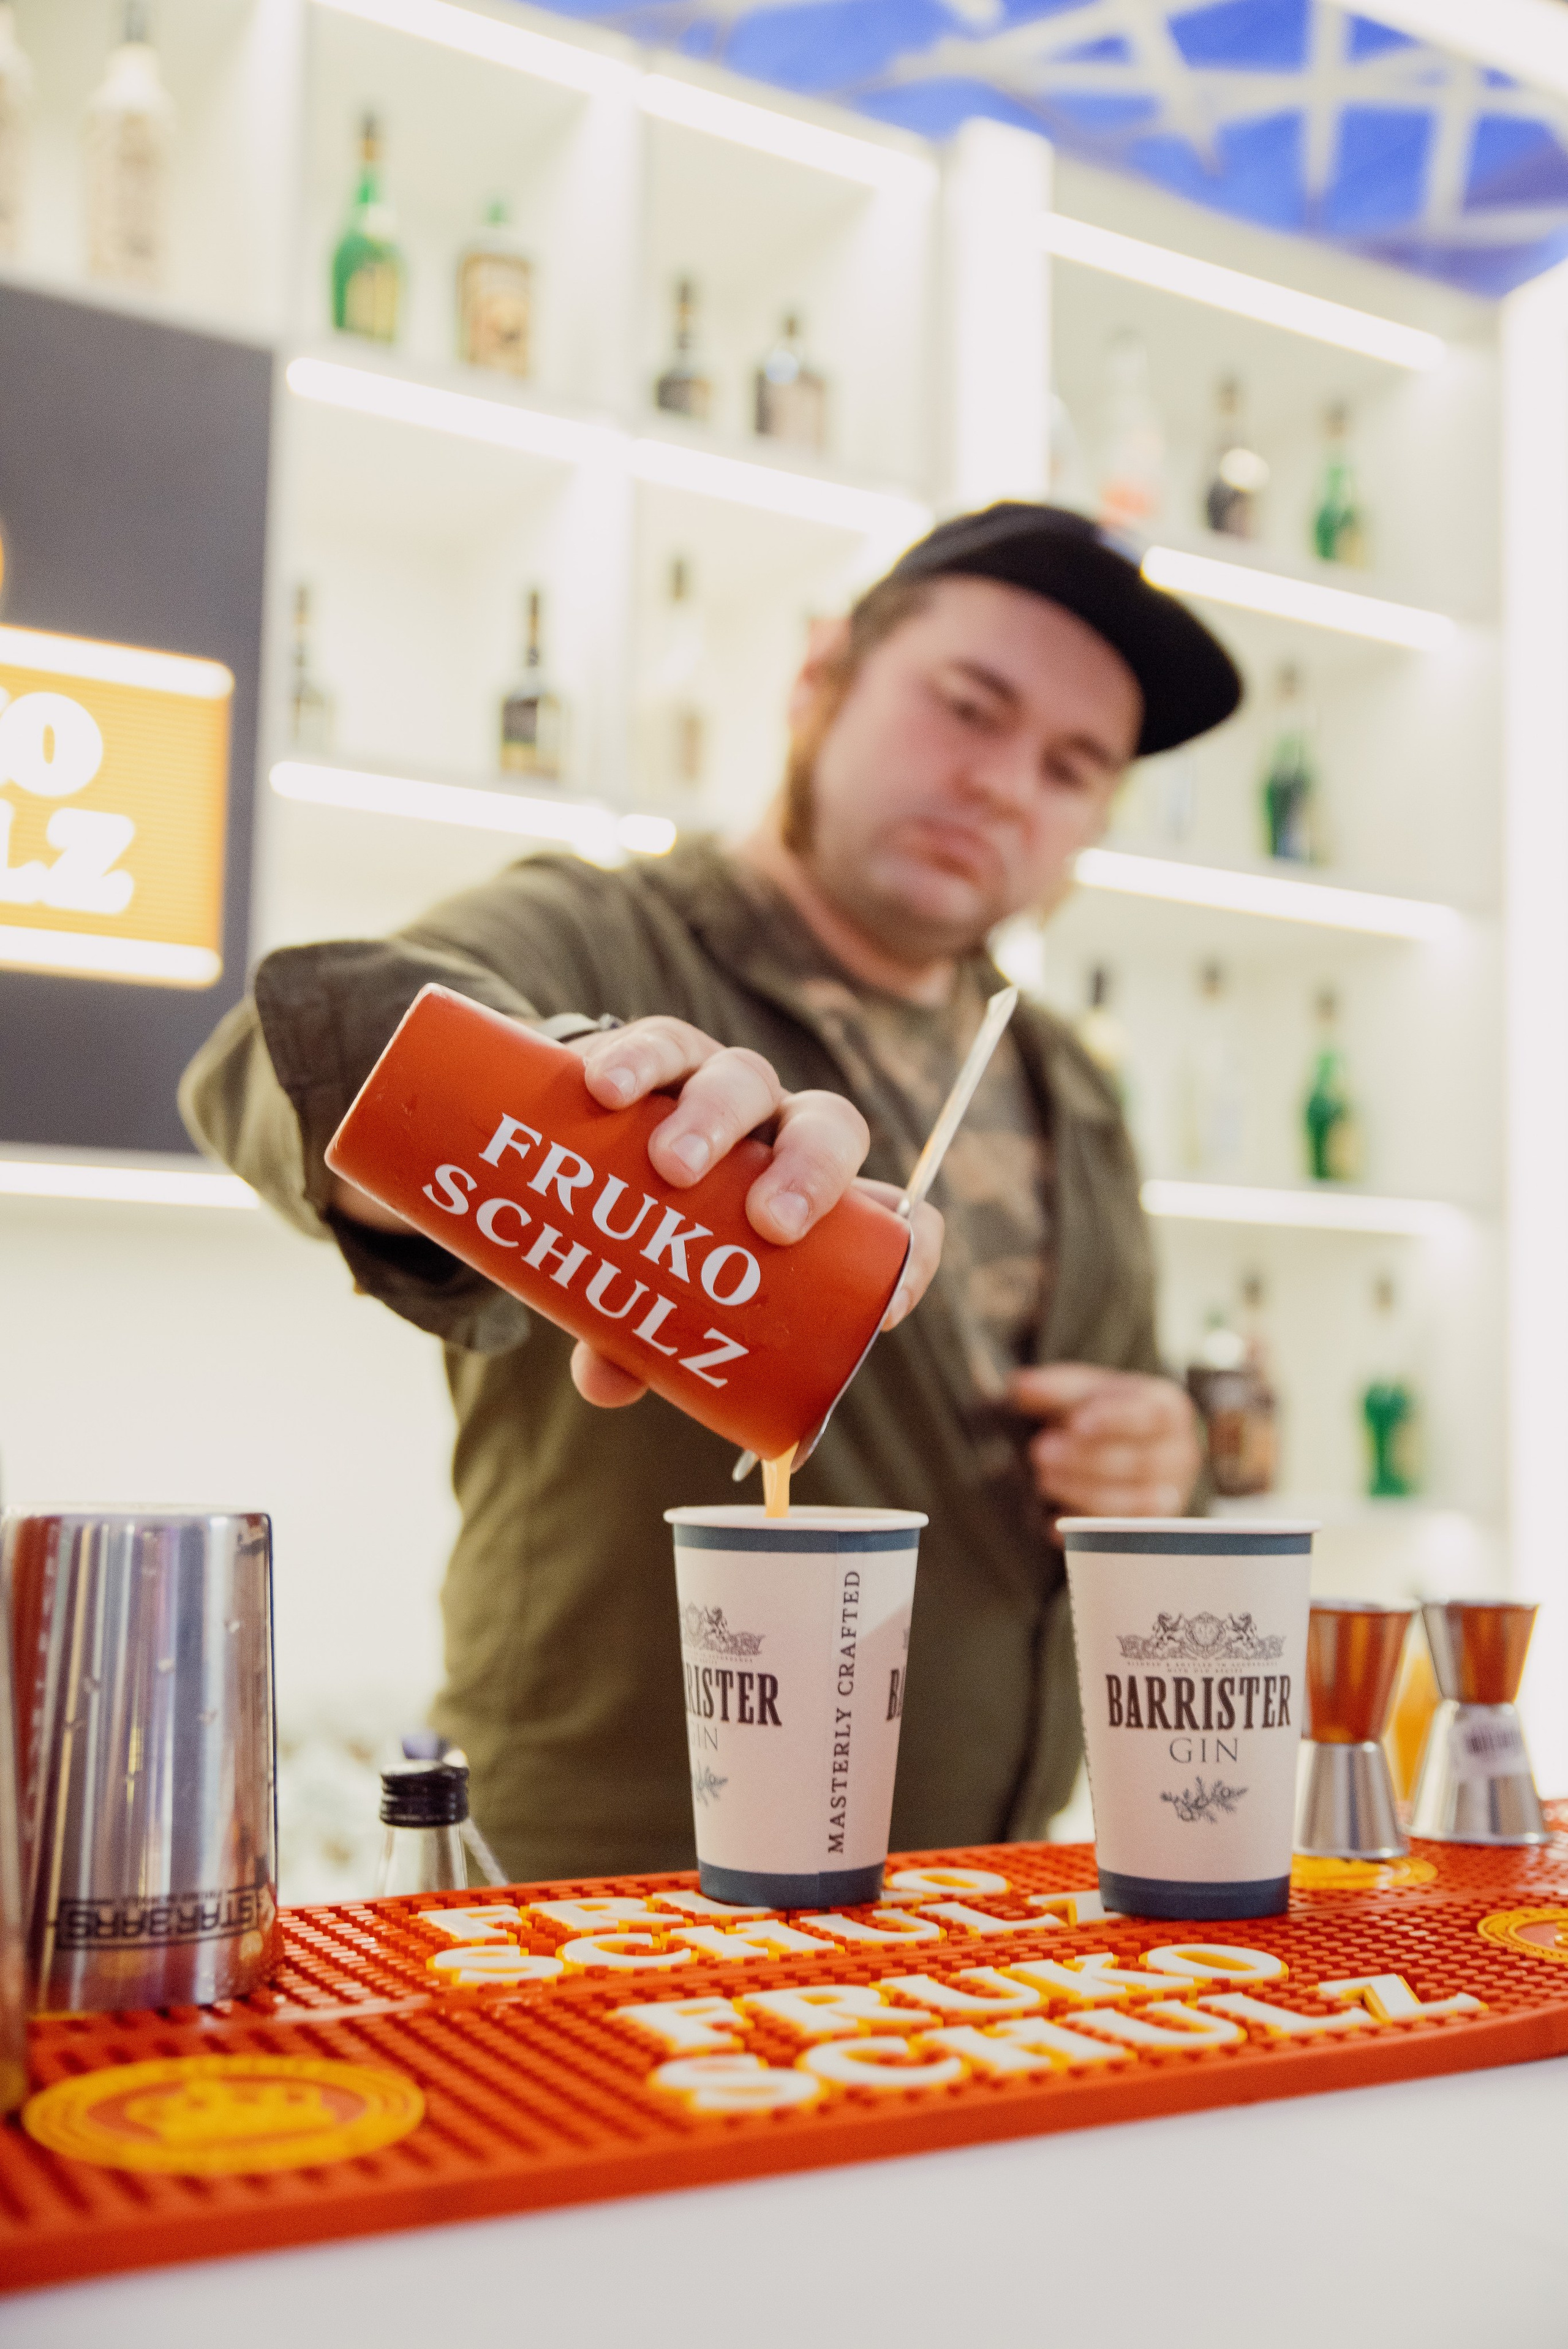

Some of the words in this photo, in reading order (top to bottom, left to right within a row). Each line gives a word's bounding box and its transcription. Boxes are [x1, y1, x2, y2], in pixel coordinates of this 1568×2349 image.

[478, 1112, 761, 1306] FRUKO
[422, 1163, 749, 1389] SCHULZ
[837, 1570, 861, 1695] CRAFTED
[1106, 1673, 1292, 1730] BARRISTER
[1169, 1737, 1239, 1764] GIN
[827, 1708, 852, 1854] MASTERLY
[614, 1942, 1283, 2051] FRUKO
[653, 1974, 1485, 2112] SCHULZ
